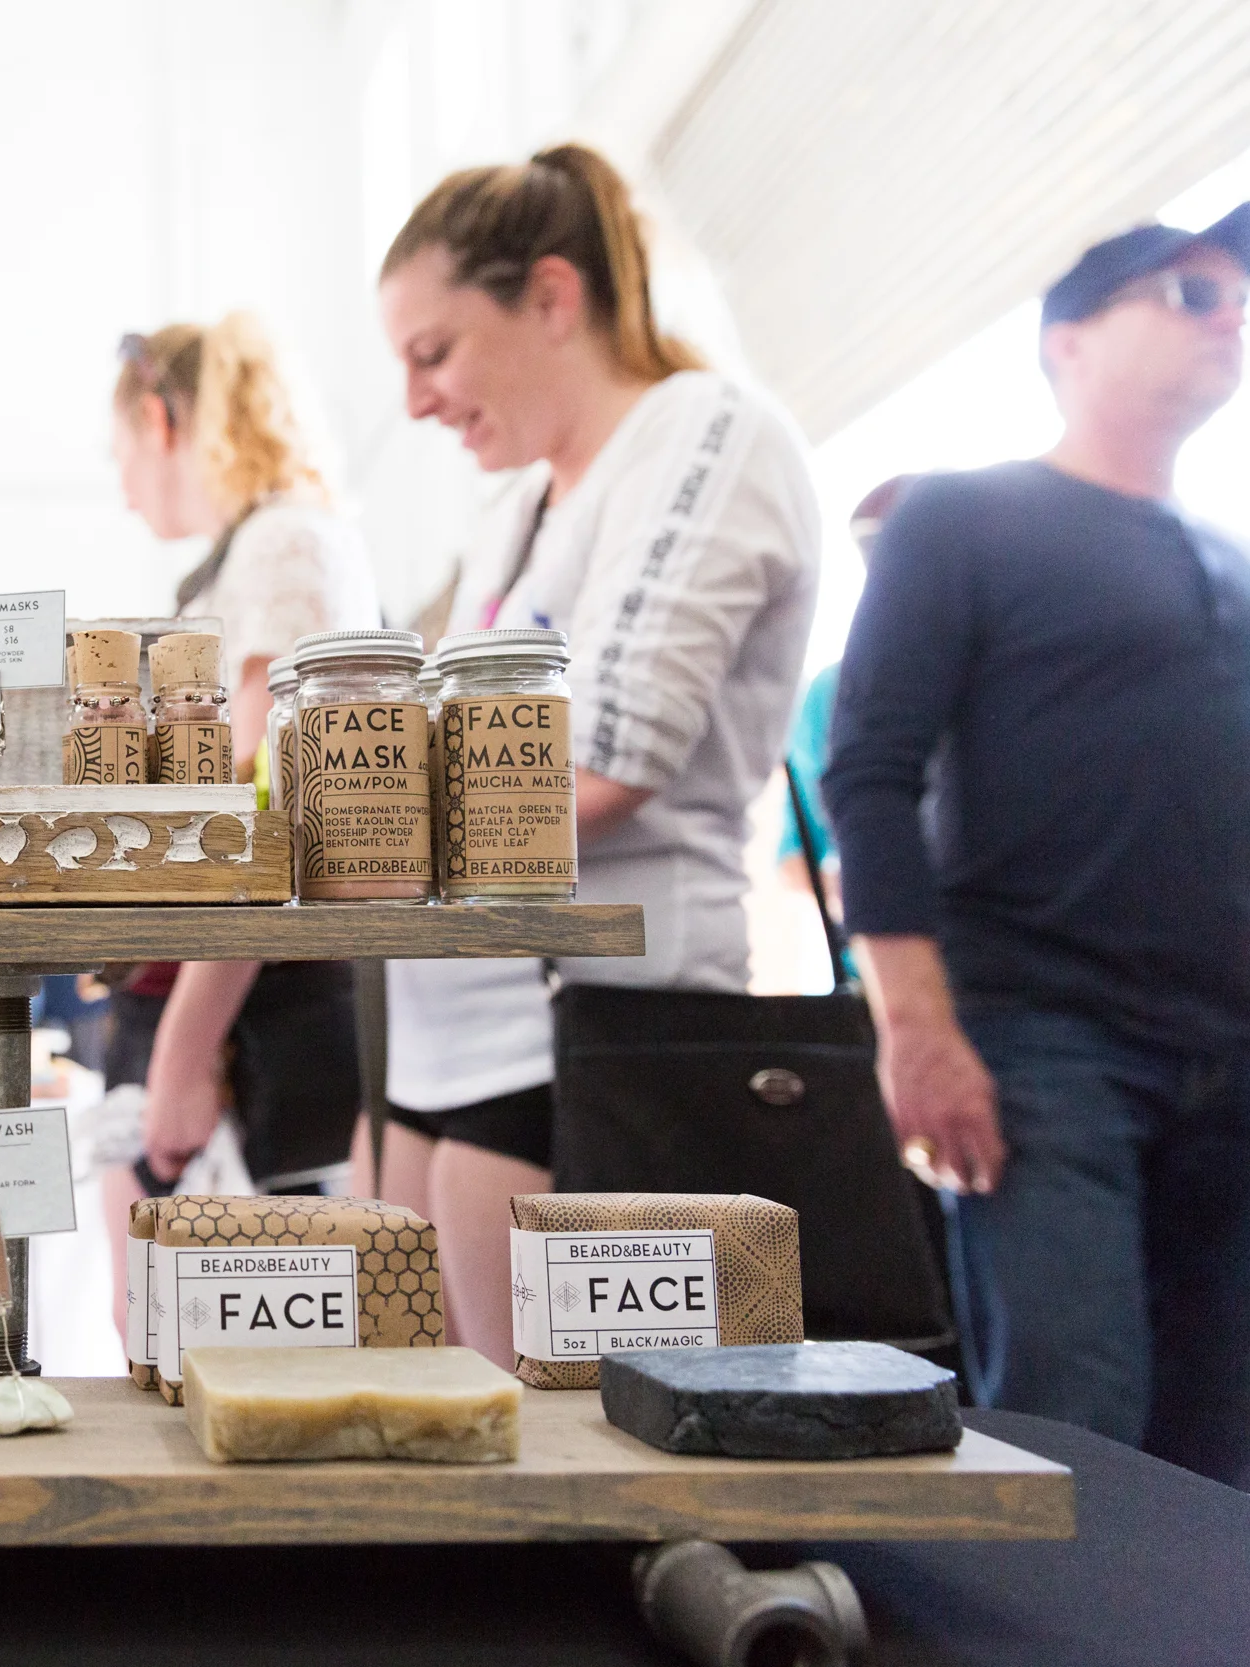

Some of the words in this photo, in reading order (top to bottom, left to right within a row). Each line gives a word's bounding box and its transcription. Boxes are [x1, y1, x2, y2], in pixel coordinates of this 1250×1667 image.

[0, 601, 39, 612] MASKS
[4, 625, 14, 634] $8
[5, 637, 18, 645] $16
[326, 708, 403, 733] FACE
[468, 704, 550, 730] FACE
[324, 745, 407, 770] MASK
[467, 742, 553, 769] MASK
[324, 777, 407, 791] POM/POM
[468, 776, 522, 789] MUCHA
[326, 806, 401, 815] POMEGRANATE
[469, 806, 512, 815] MATCHA
[519, 805, 550, 813] GREEN
[555, 806, 567, 814] TEA
[326, 817, 350, 826] ROSE
[357, 817, 393, 825] KAOLIN
[398, 817, 418, 825] CLAY
[469, 817, 513, 826] ALFALFA
[519, 816, 560, 825] POWDER
[326, 828, 367, 837] ROSEHIP
[372, 828, 413, 836] POWDER
[469, 828, 502, 837] GREEN
[508, 828, 536, 836] CLAY
[326, 838, 381, 848] BENTONITE
[386, 838, 410, 846] CLAY
[469, 839, 498, 848] OLIVE
[504, 838, 529, 847] LEAF
[570, 1243, 691, 1258] BEARD&BEAUTY
[201, 1258, 330, 1272] BEARD&BEAUTY
[589, 1276, 705, 1313] FACE
[220, 1292, 343, 1330] FACE
[564, 1339, 586, 1349] 5oz
[611, 1336, 703, 1348] BLACK/MAGIC
